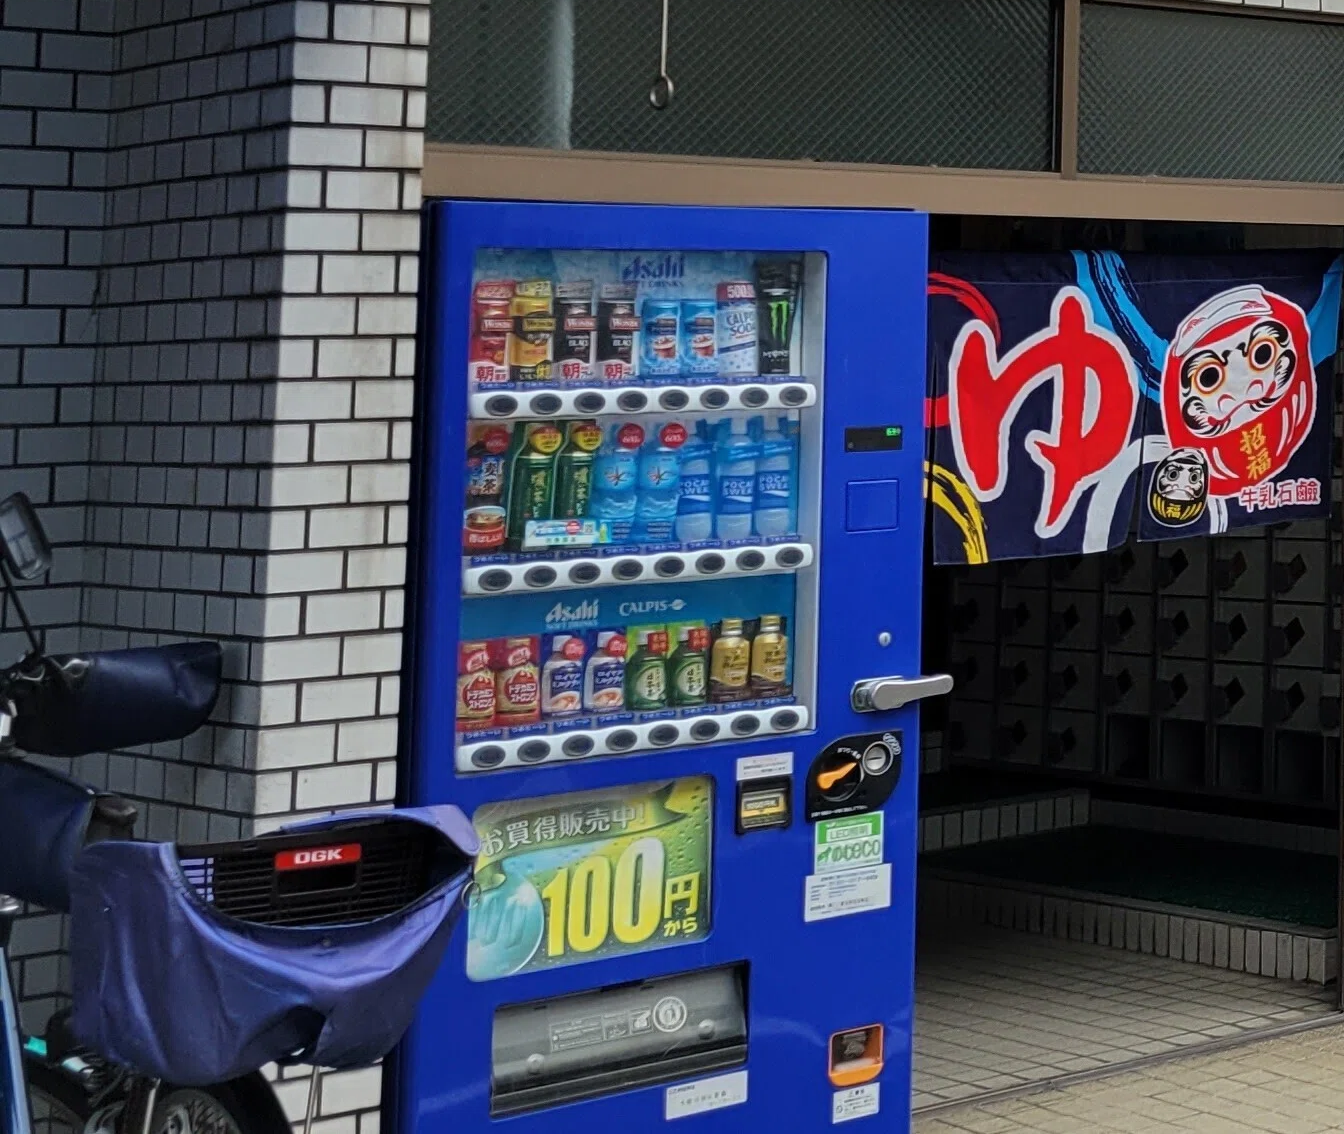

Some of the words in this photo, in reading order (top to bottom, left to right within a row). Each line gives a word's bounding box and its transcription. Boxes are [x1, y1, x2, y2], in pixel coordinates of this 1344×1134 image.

[950, 286, 1140, 538] ゆ
[1240, 422, 1271, 480] 招福
[1165, 503, 1182, 519] 福
[545, 598, 599, 623] Asahi
[620, 600, 668, 616] CALPIS
[294, 848, 343, 865] OGK
[663, 916, 699, 937] から
